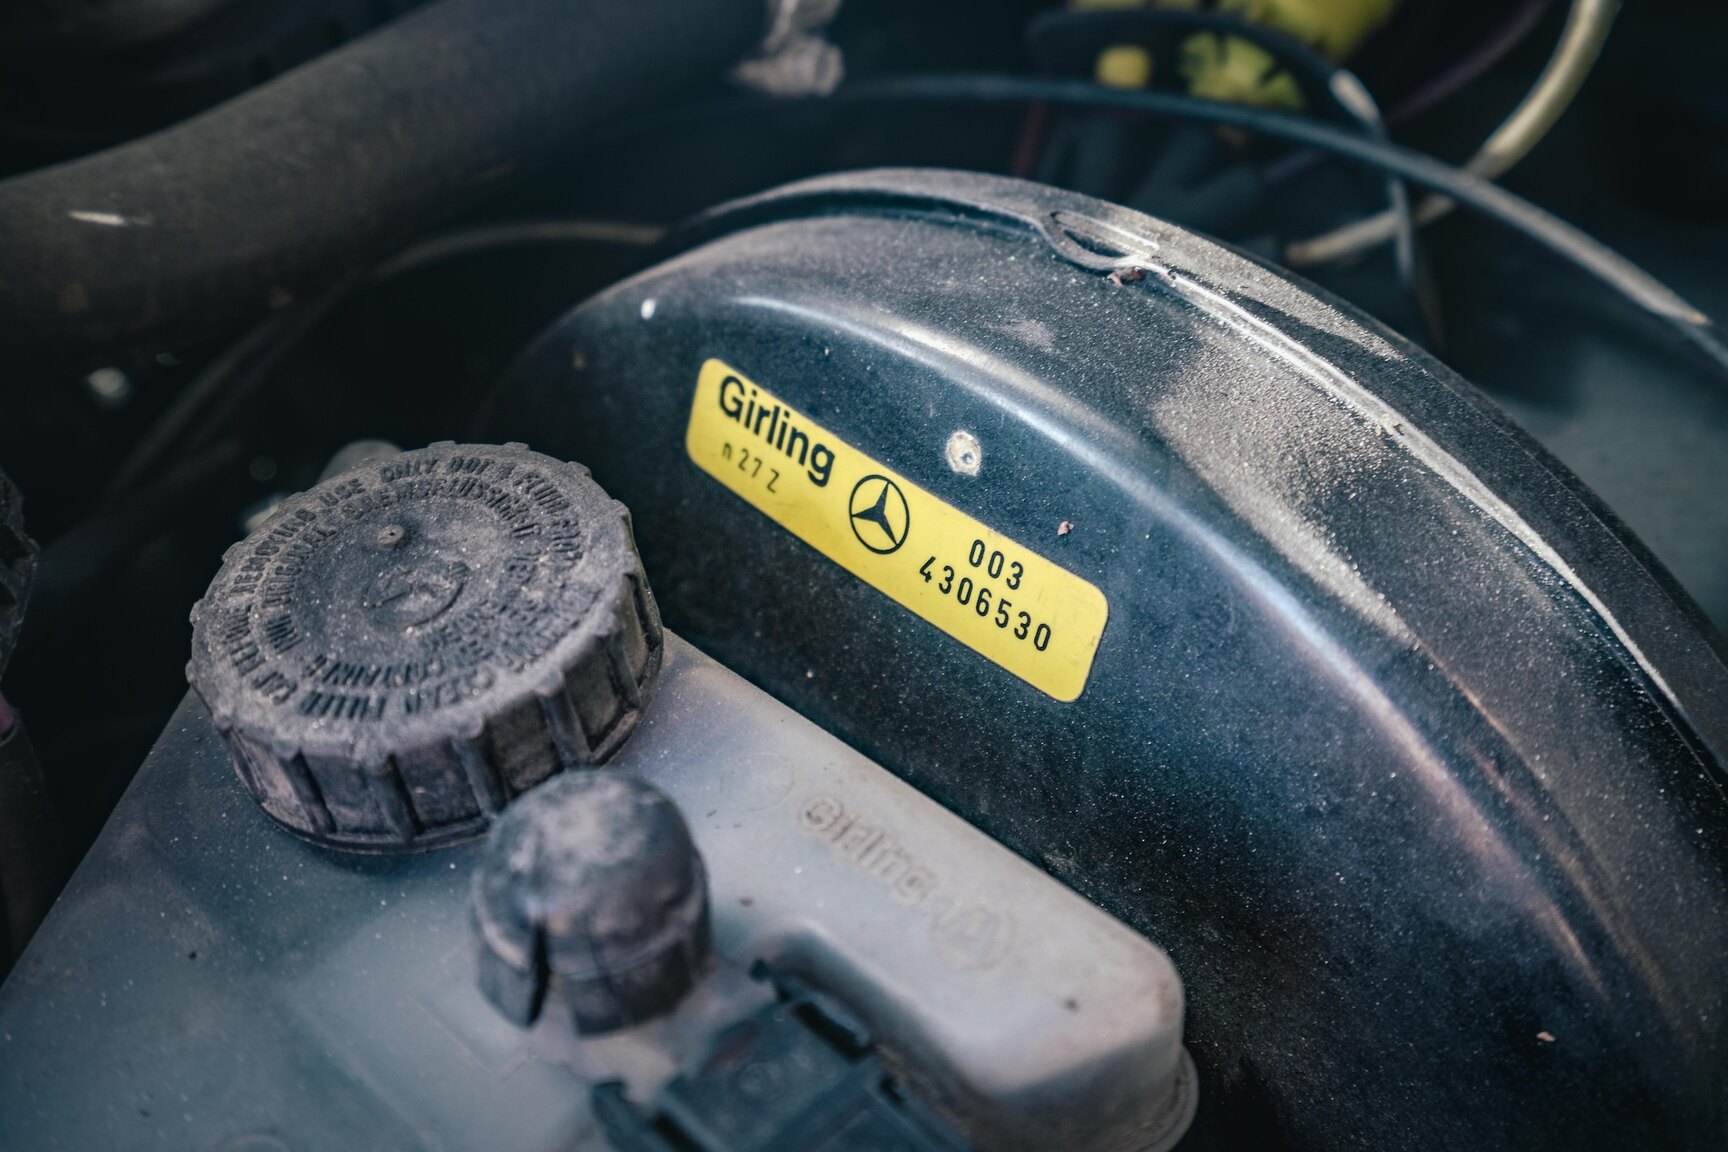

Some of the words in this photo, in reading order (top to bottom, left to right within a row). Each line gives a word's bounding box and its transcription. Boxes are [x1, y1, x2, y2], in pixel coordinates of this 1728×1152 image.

[718, 375, 835, 488] Girling
[738, 447, 762, 478] 27
[968, 539, 1024, 590] 003
[919, 556, 1052, 652] 4306530
